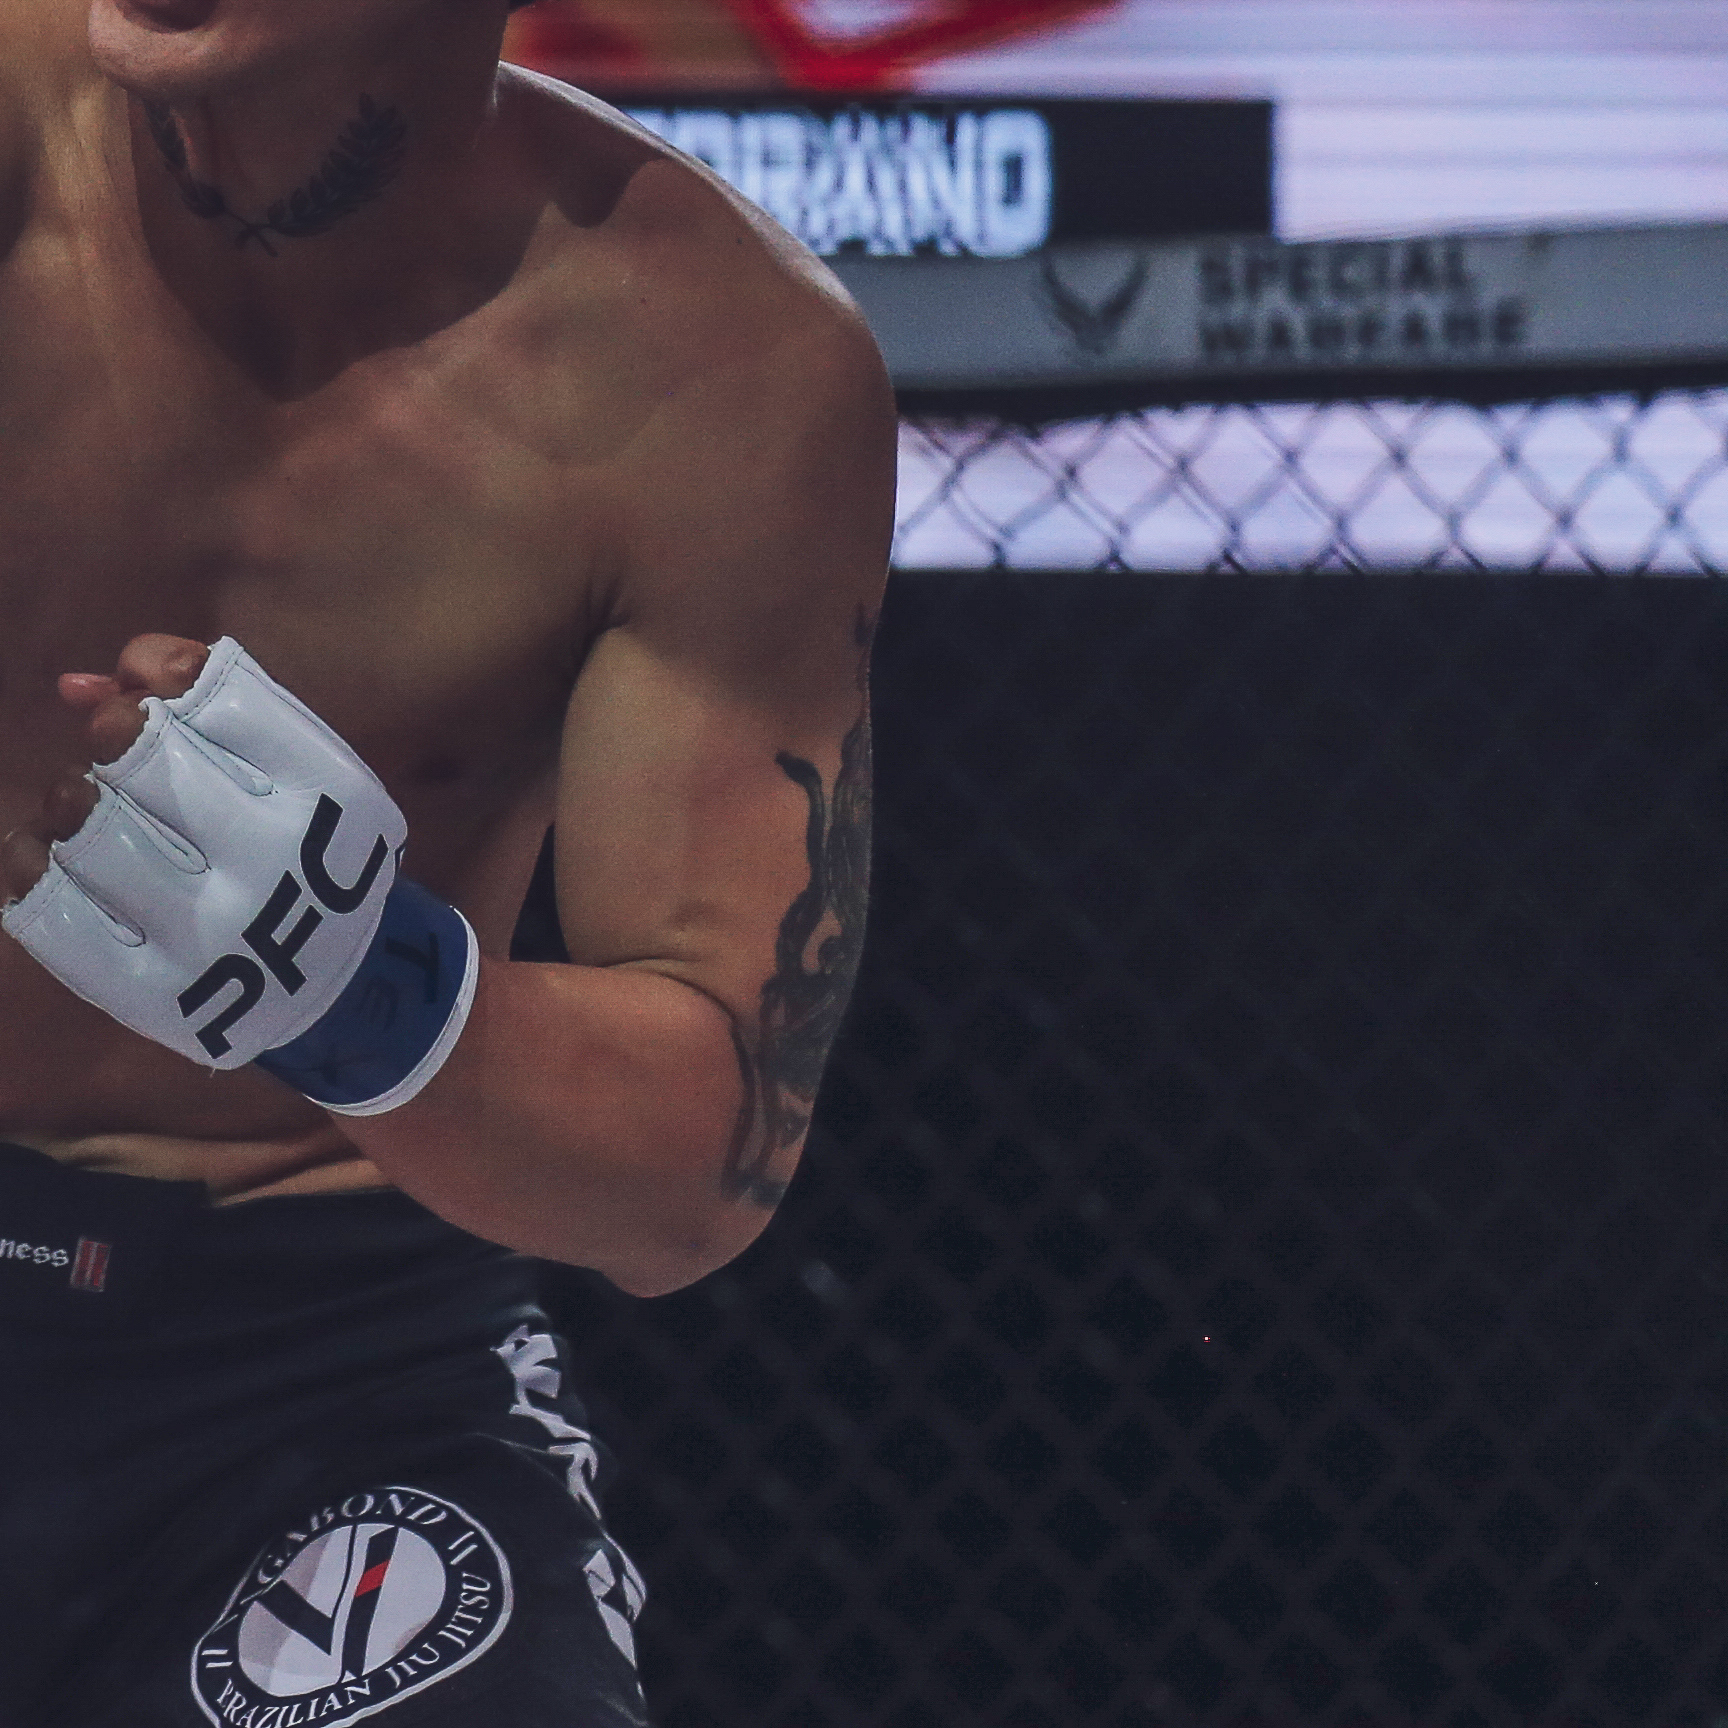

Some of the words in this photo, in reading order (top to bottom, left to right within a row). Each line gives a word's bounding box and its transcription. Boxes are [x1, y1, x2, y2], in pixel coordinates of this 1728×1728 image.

[177, 793, 389, 1060] PFC
[384, 1642, 441, 1690] JIU
[437, 1572, 492, 1649] JITSU
